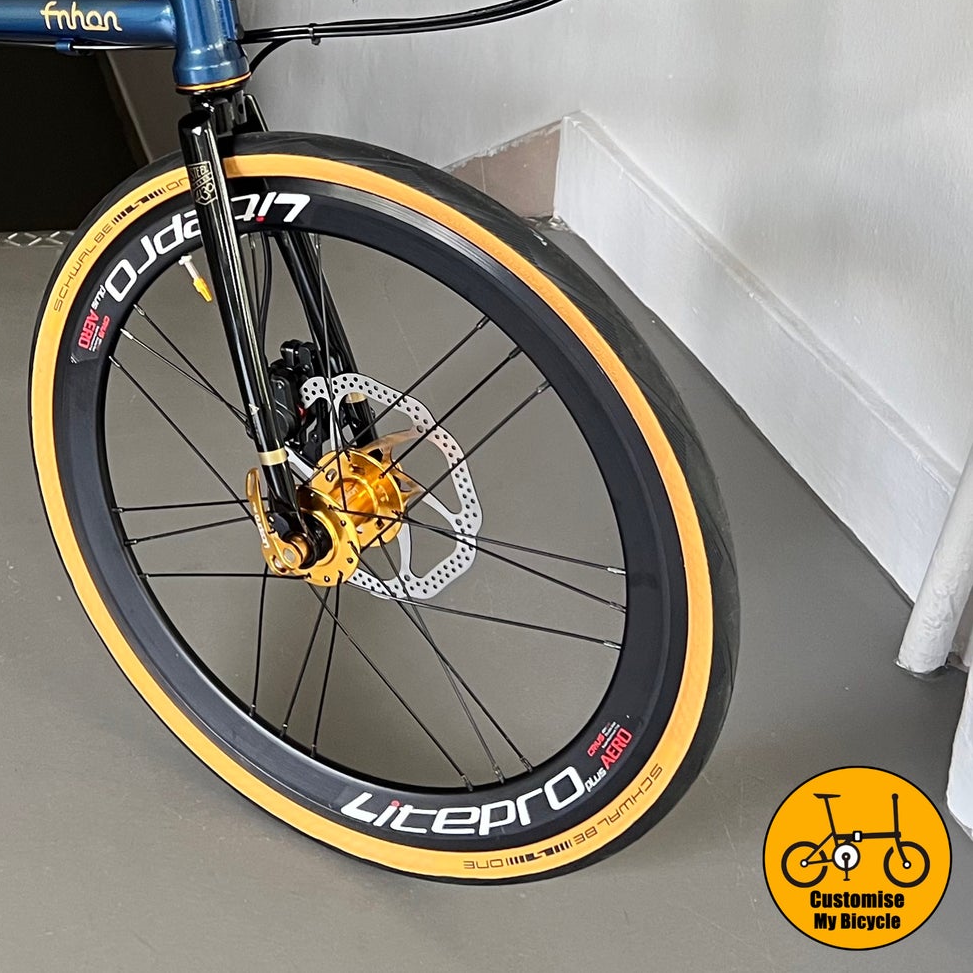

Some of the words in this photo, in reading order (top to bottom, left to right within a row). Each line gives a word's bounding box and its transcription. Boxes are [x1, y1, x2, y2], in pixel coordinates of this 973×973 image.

[53, 224, 114, 313] SCHWALBE
[165, 177, 190, 192] ON
[78, 308, 99, 349] AERO
[340, 766, 586, 836] Litepro
[584, 767, 607, 793] plus
[600, 727, 633, 771] AERO
[573, 762, 664, 845] SCHWALBE
[463, 858, 504, 870] ONE
